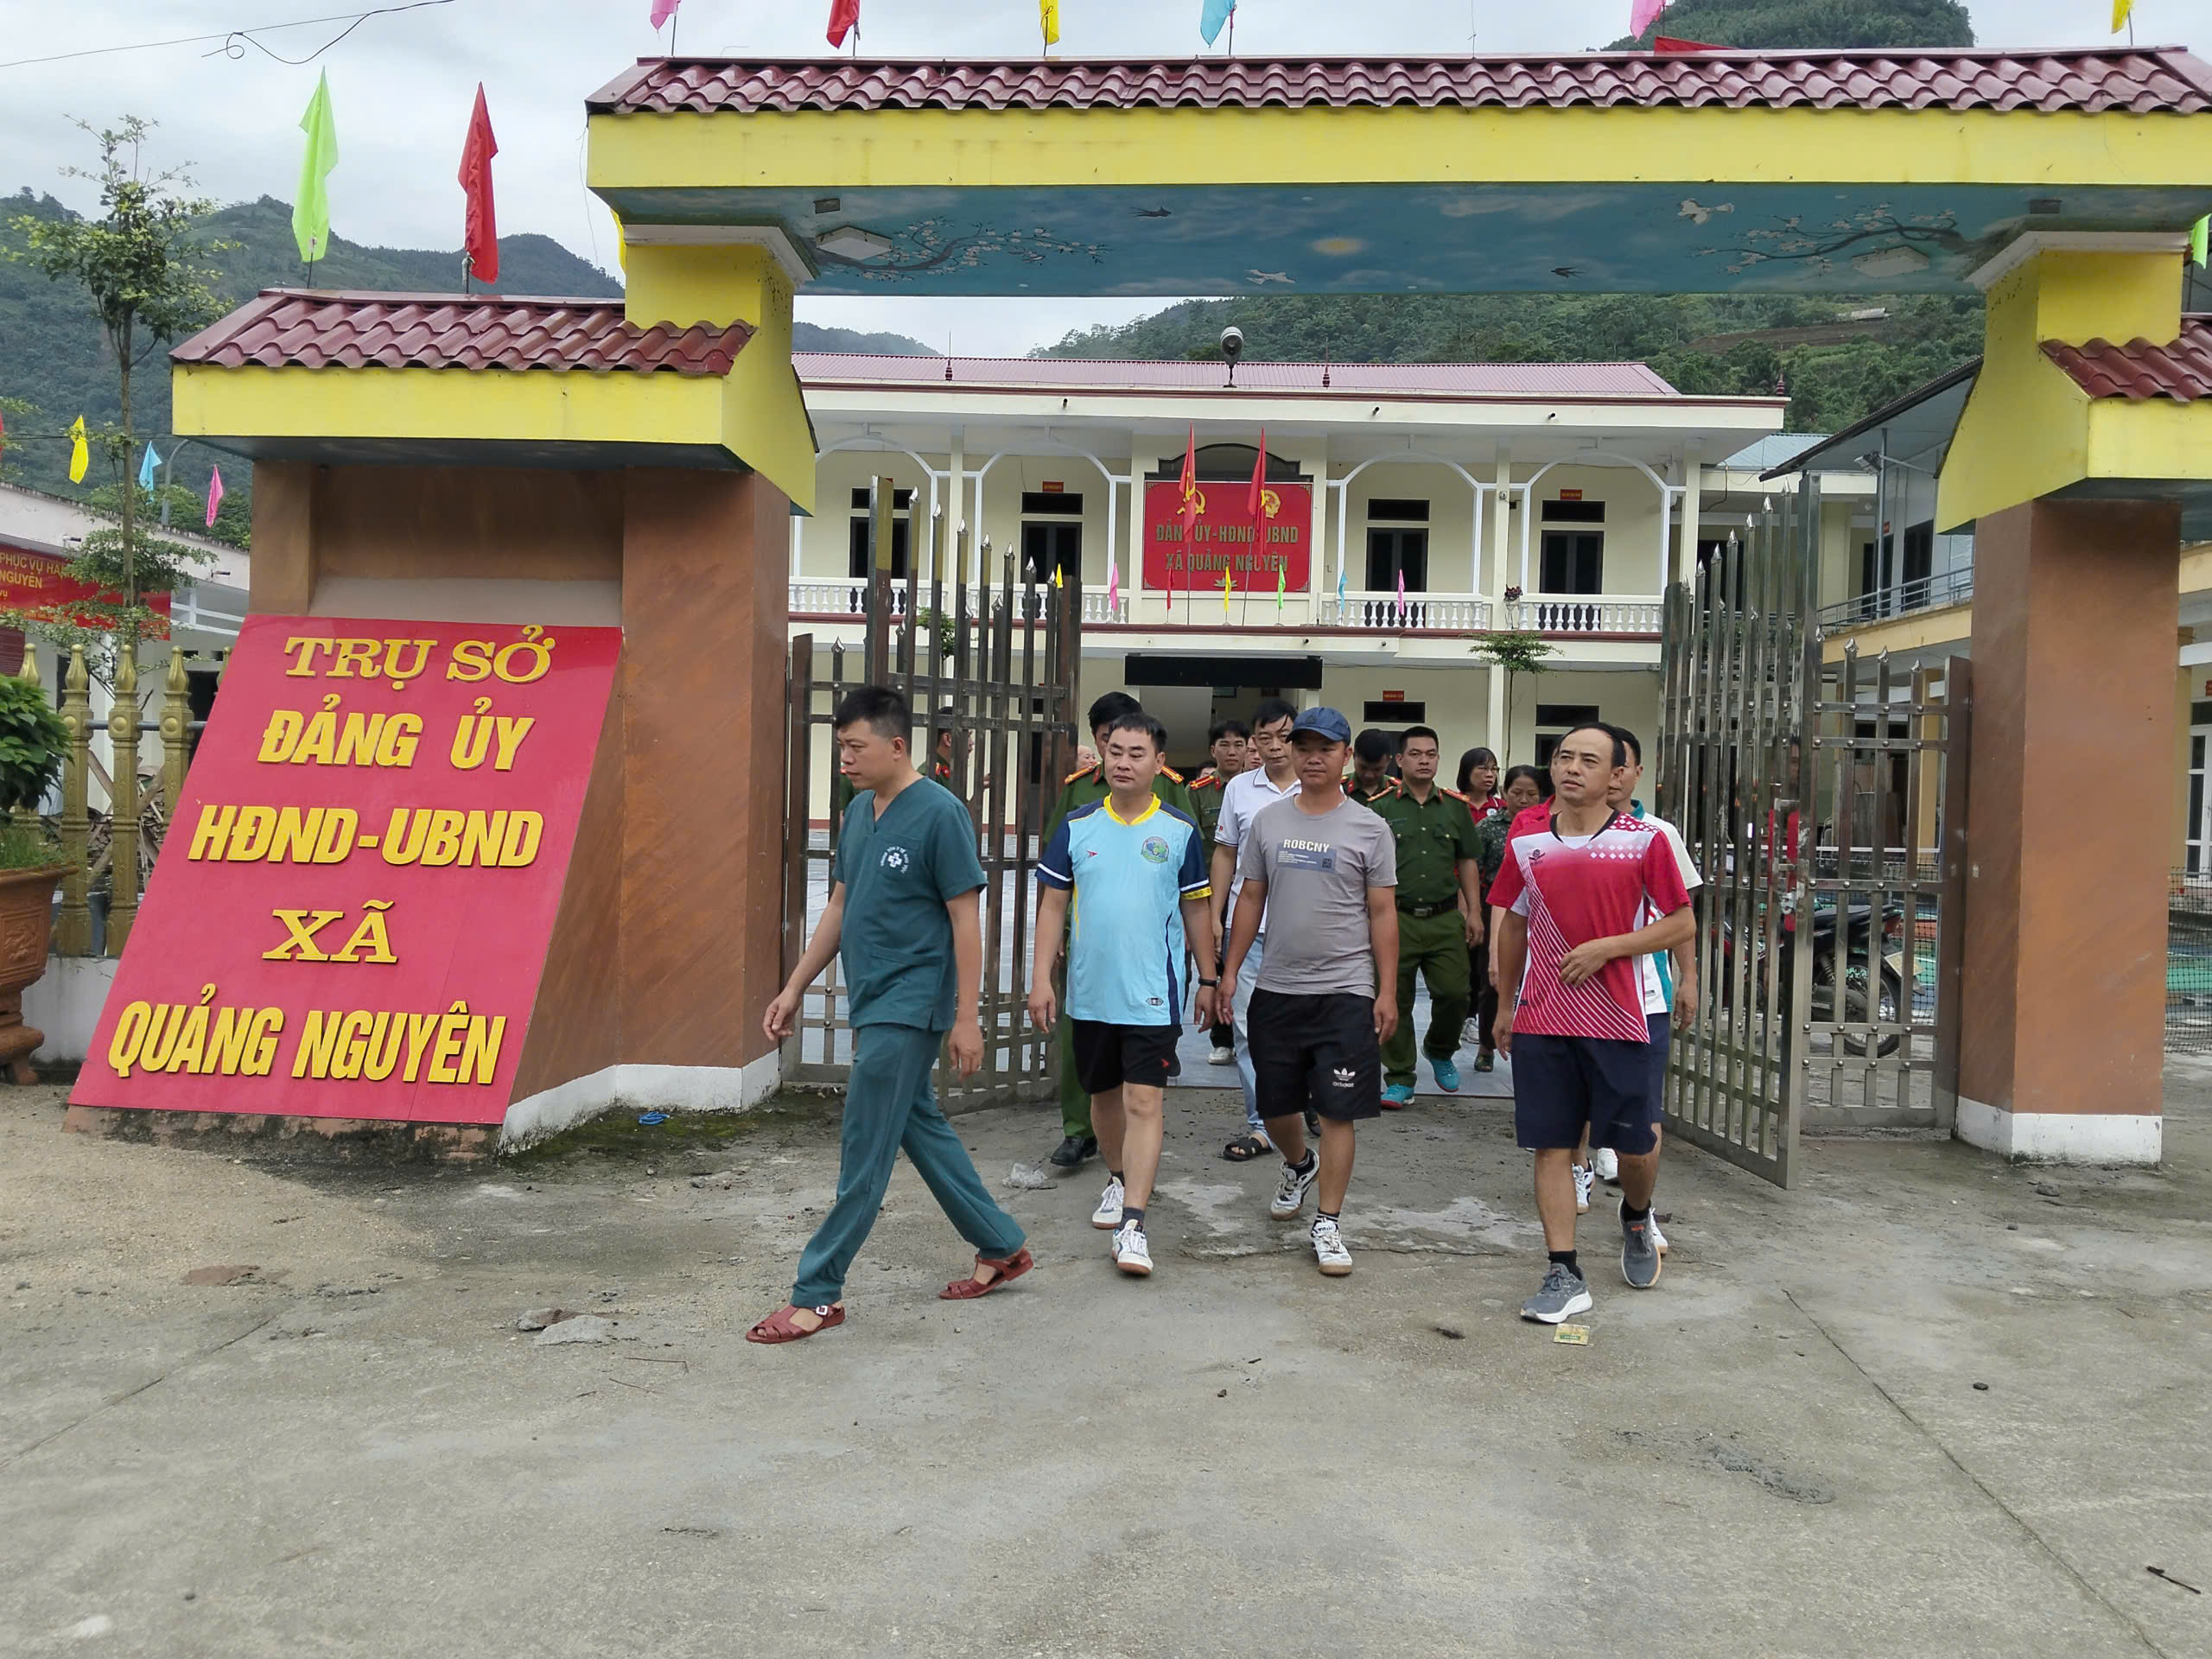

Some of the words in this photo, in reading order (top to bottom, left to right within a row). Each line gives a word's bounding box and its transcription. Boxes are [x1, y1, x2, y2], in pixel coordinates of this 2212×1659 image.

[1155, 519, 1184, 543] ĐẢN
[1166, 549, 1183, 571] XÃ
[1187, 549, 1230, 572] QUẢNG
[29, 557, 43, 575] VỤ
[285, 637, 436, 690] TRỤ
[447, 624, 556, 683] SỞ
[257, 693, 423, 767] ĐẢNG
[450, 696, 534, 770] ỦY
[188, 805, 543, 868] HĐND-UBND
[1283, 839, 1330, 853] ROBCNY
[262, 899, 398, 963] XÃ
[108, 983, 284, 1077] QUẢNG
[291, 1001, 506, 1084] NGUYÊN
